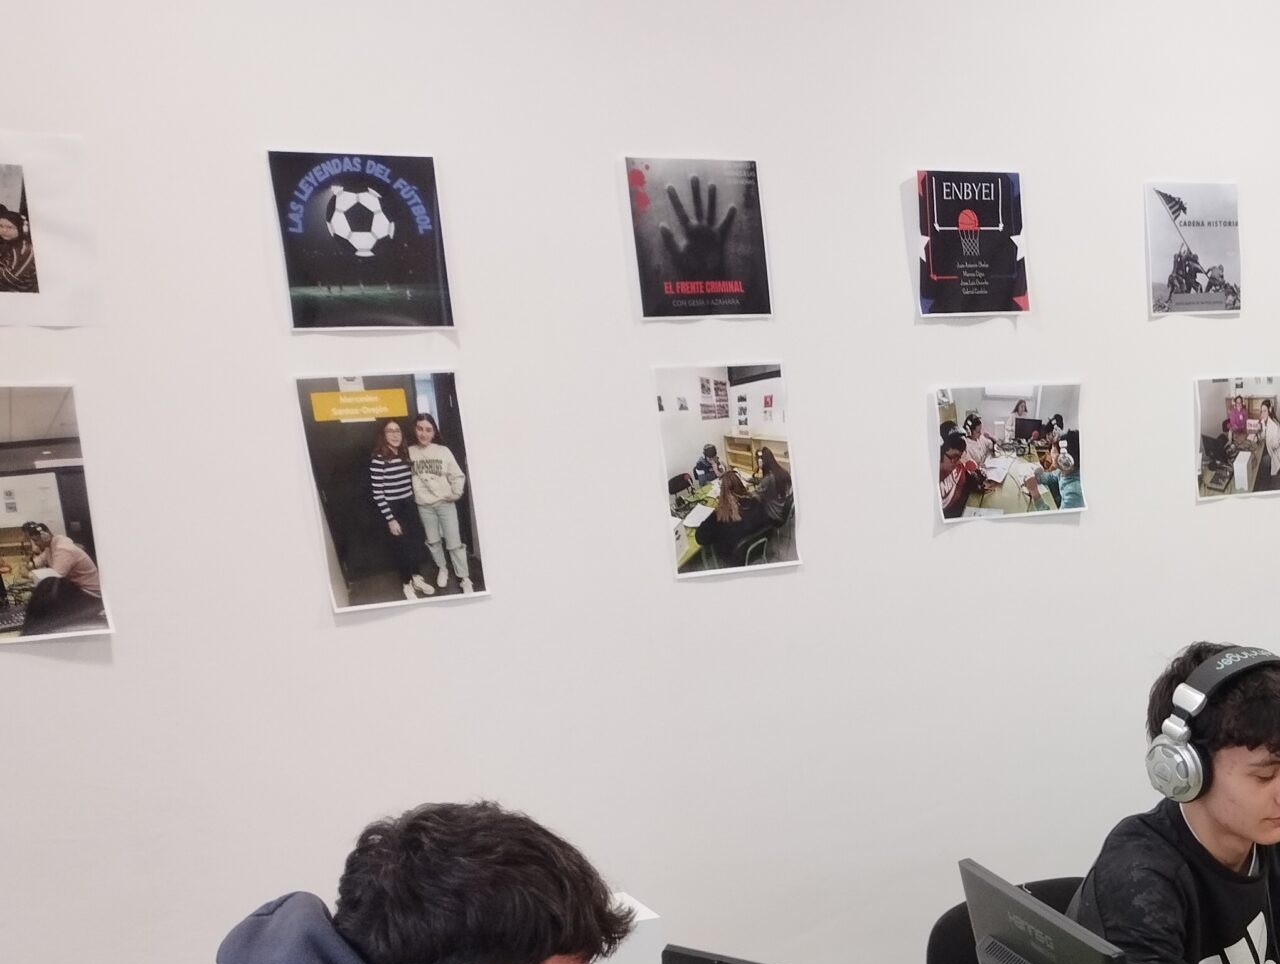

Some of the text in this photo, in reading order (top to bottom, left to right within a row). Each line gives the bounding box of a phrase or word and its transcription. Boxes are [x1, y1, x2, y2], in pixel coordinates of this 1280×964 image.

[289, 156, 433, 235] LAS LEYENDAS DEL FÚTBOL
[943, 182, 994, 201] ENBYEI
[664, 281, 744, 294] EL FRENTE CRIMINAL
